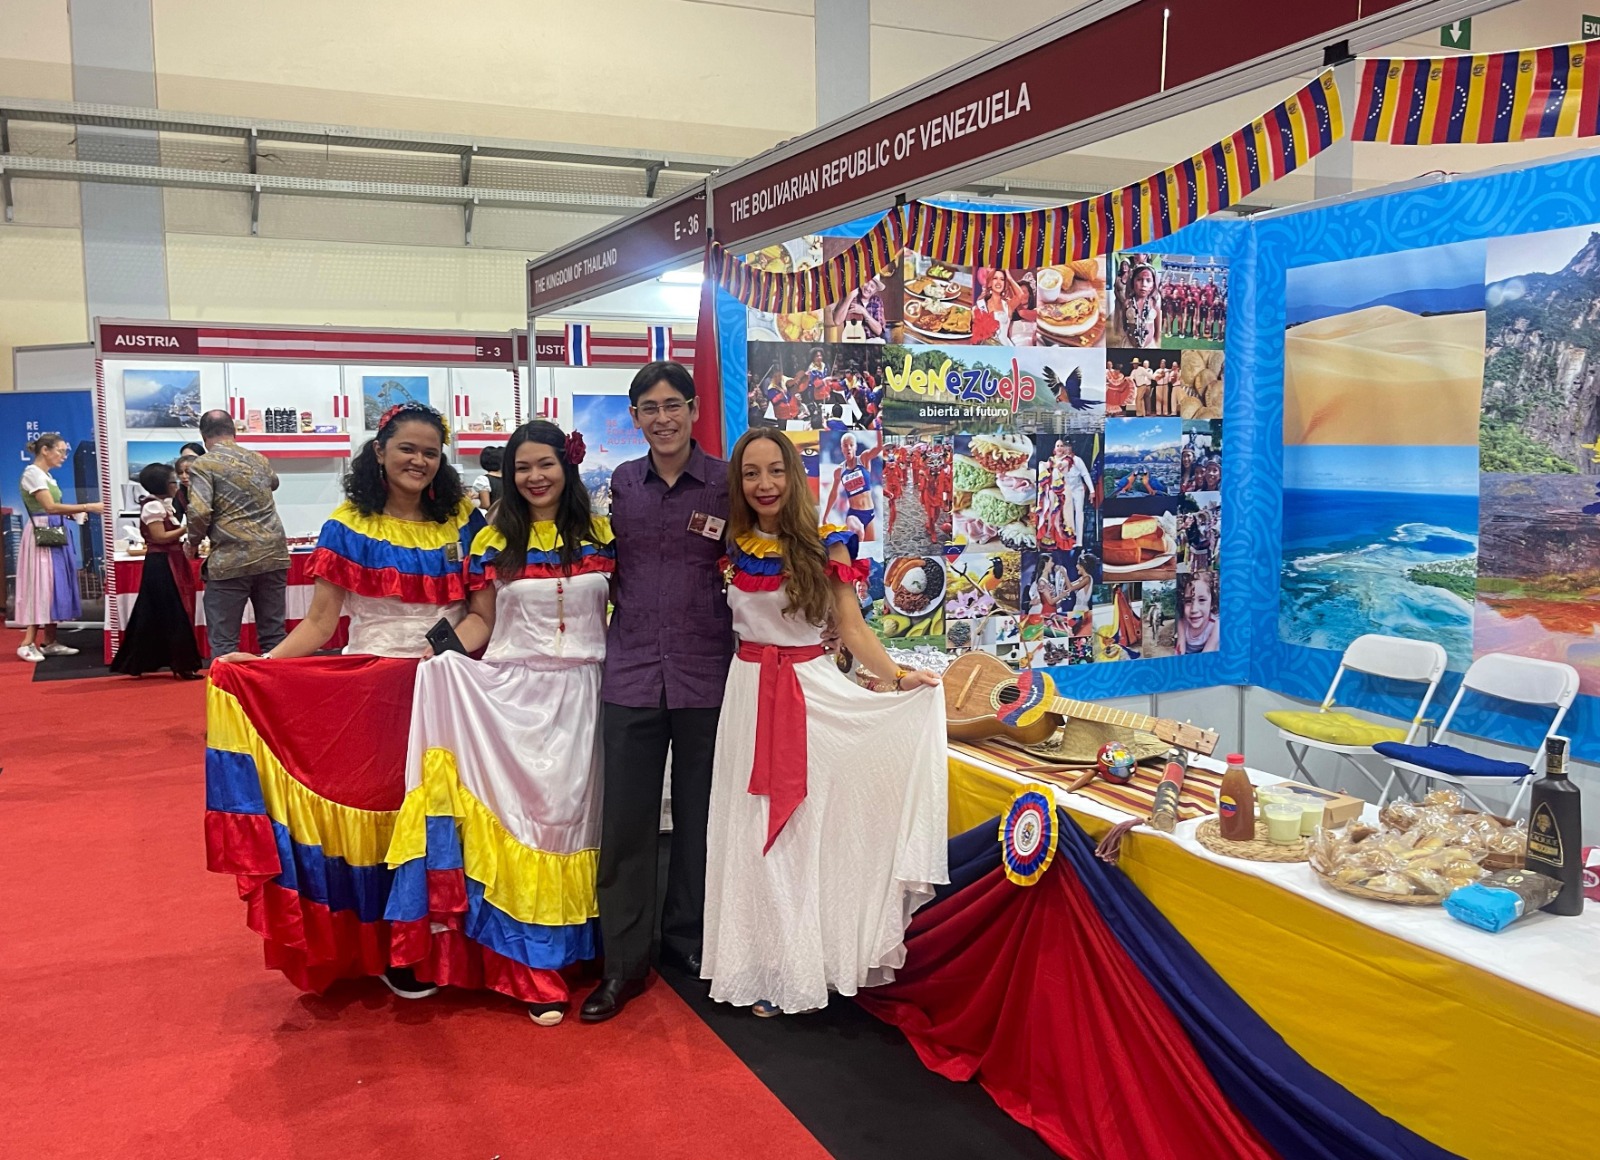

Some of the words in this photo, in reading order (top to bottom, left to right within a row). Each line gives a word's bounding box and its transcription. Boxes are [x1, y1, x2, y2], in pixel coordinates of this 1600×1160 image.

[1584, 21, 1600, 35] EXI
[731, 196, 750, 223] THE
[752, 168, 819, 215] BOLIVARIAN
[822, 139, 890, 188] REPUBLIC
[894, 128, 916, 160] OF
[920, 82, 1031, 151] VENEZUELA
[674, 221, 681, 241] E
[688, 213, 699, 235] 36
[535, 277, 545, 294] THE
[546, 267, 573, 288] KINGDOM
[574, 262, 583, 279] OF
[584, 248, 618, 275] THAILAND
[115, 334, 180, 348] AUSTRIA
[476, 346, 484, 356] E
[494, 347, 501, 357] 3
[535, 344, 565, 355] USTR
[919, 406, 960, 417] abierta
[964, 406, 974, 417] al
[976, 406, 1009, 417] futuro
[26, 421, 39, 431] RE
